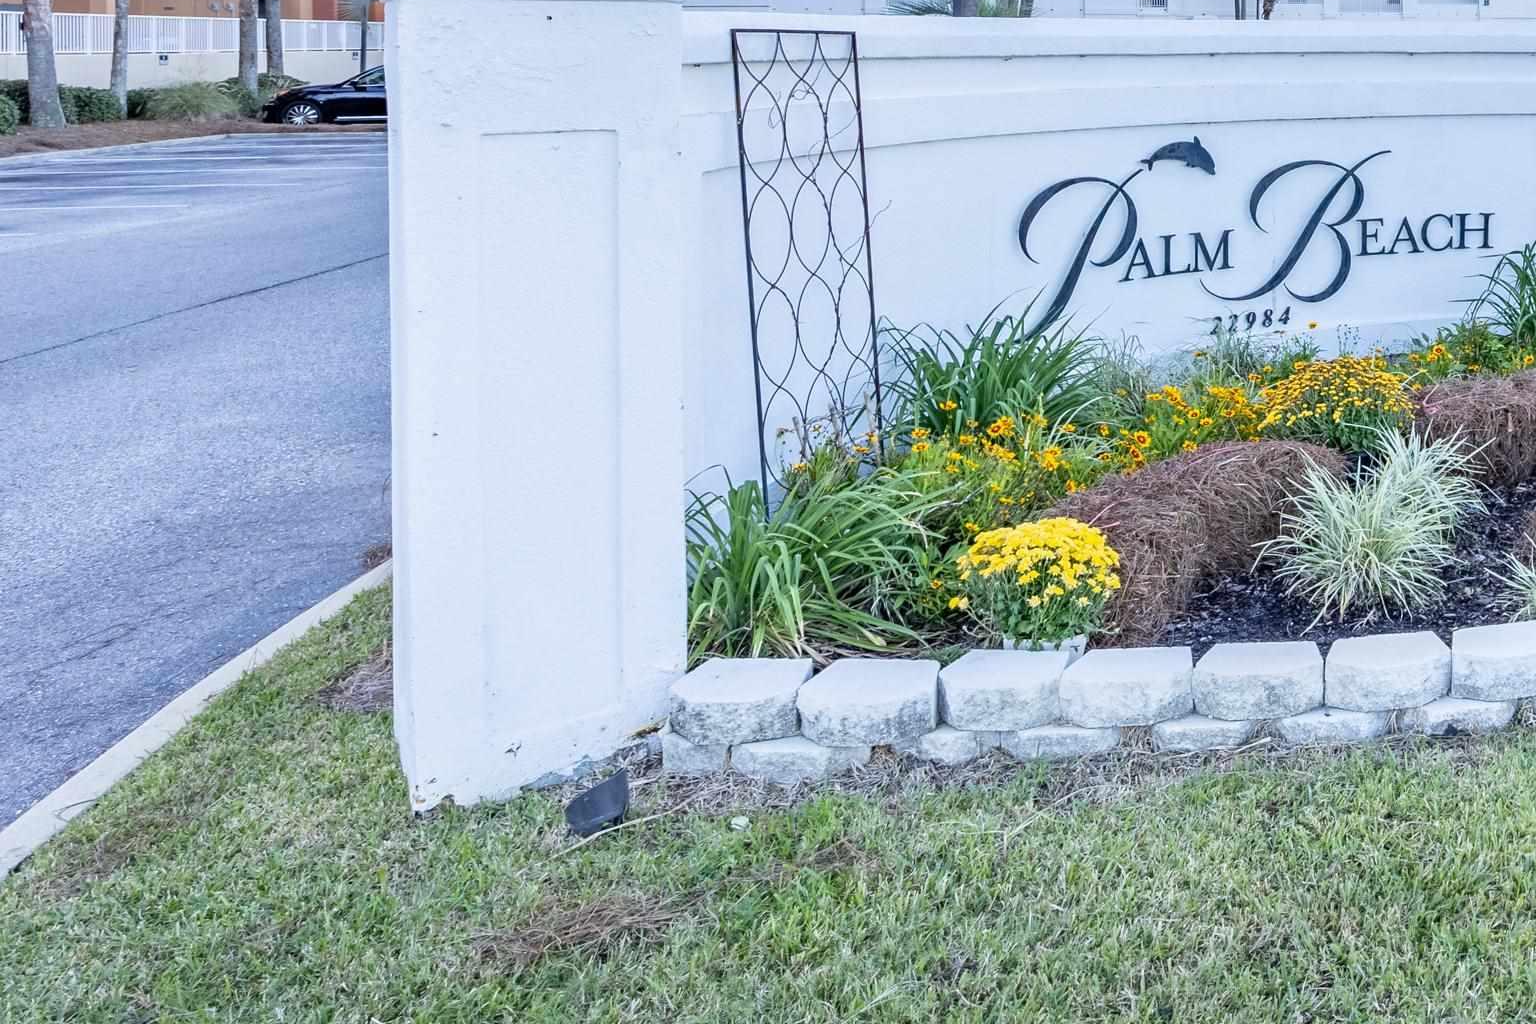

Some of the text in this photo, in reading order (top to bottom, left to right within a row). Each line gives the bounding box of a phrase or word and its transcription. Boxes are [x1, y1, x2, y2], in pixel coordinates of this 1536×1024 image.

[1008, 150, 1495, 344] PALM BEACH
[1210, 306, 1290, 335] 22984
